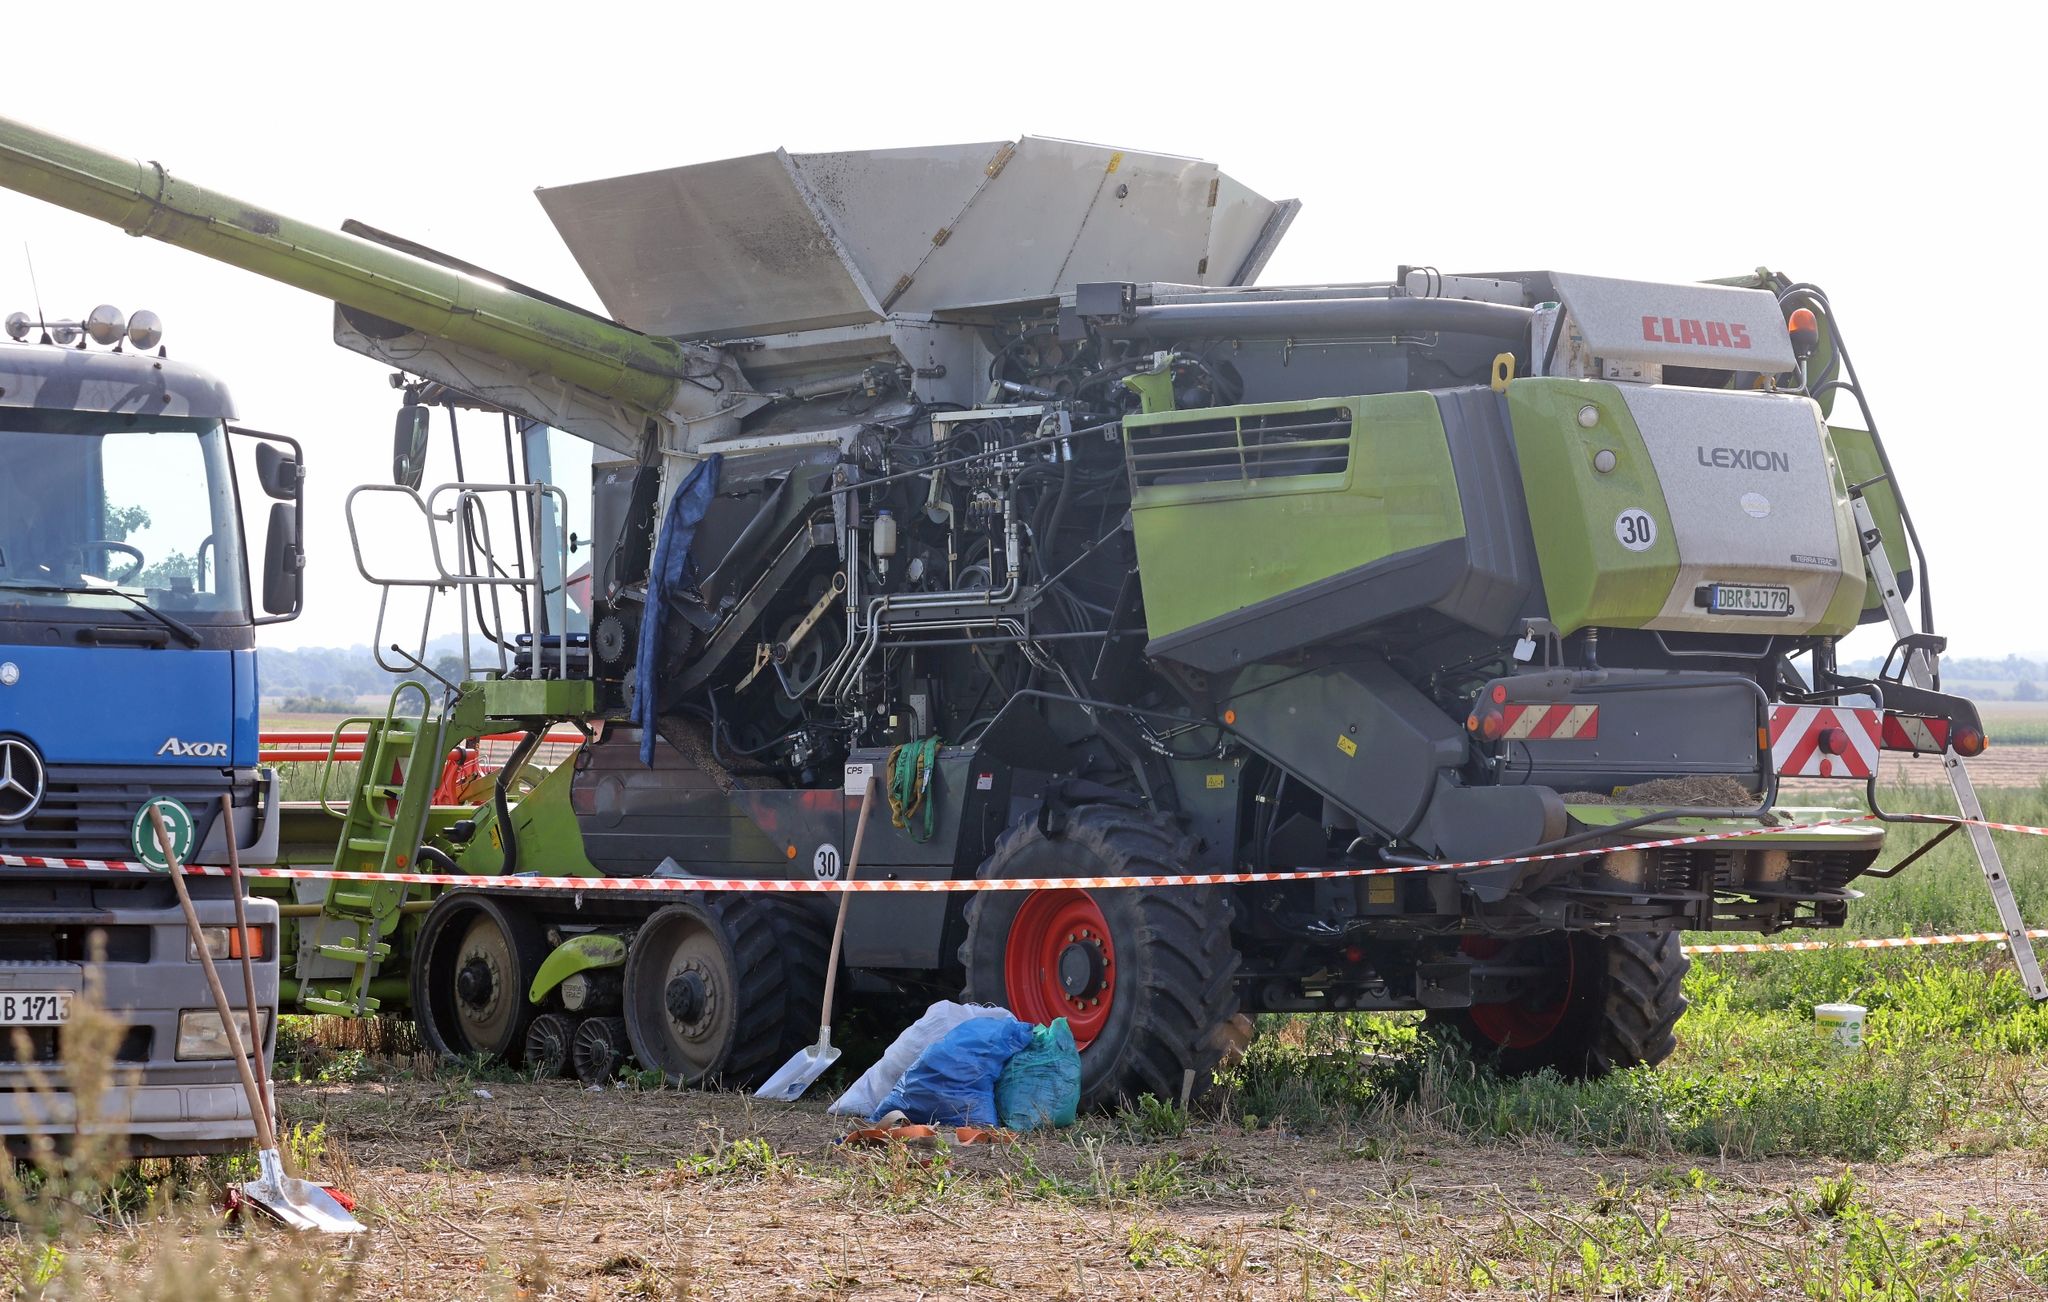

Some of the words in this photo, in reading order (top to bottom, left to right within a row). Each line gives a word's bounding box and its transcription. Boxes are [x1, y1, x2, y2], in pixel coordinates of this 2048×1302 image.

[1641, 315, 1752, 349] CLAAS
[1697, 446, 1790, 473] LEXION
[1620, 515, 1650, 544] 30
[1718, 589, 1743, 608] DBR
[156, 737, 228, 757] AXOR
[846, 766, 863, 775] CPS
[153, 815, 176, 853] G
[818, 851, 835, 877] 30
[4, 996, 16, 1020] B
